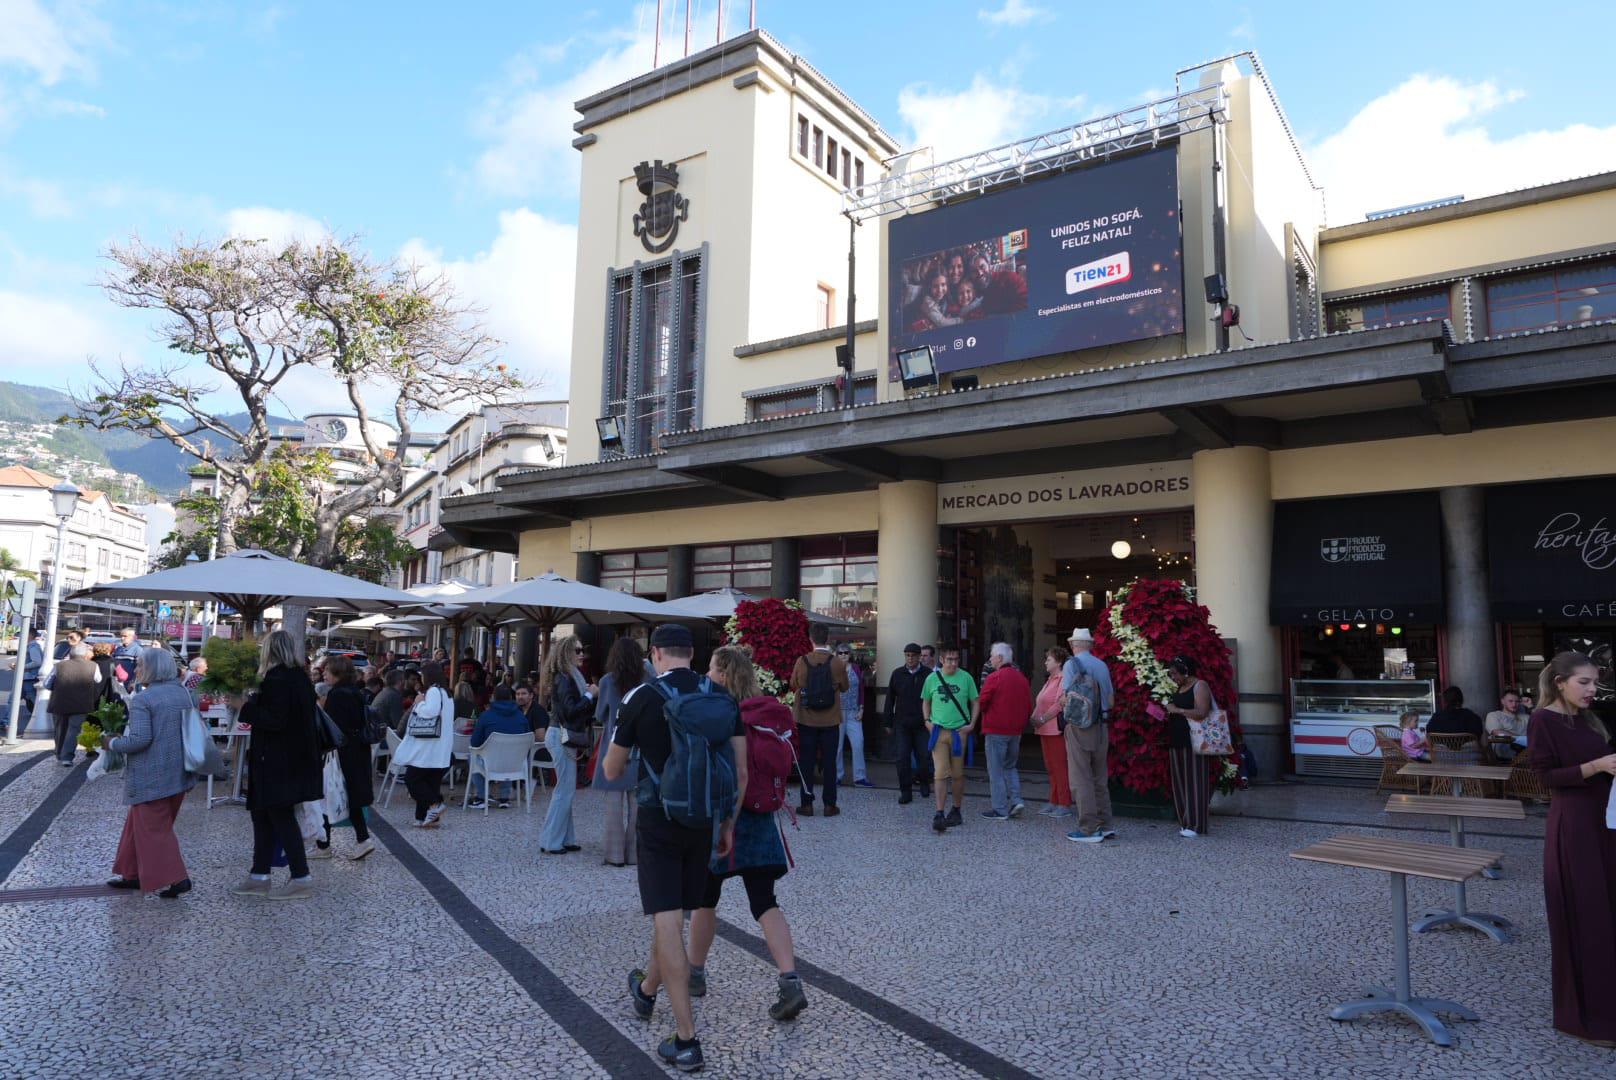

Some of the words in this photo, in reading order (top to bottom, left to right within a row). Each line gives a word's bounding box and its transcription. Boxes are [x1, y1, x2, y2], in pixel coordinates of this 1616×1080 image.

[1051, 221, 1090, 238] UNIDOS
[1093, 216, 1109, 229] NO
[1111, 207, 1143, 224] SOFÁ.
[1062, 235, 1090, 250] FELIZ
[1092, 225, 1132, 243] NATAL!
[1038, 302, 1082, 317] Especialistas
[1082, 299, 1095, 308] em
[1095, 287, 1163, 306] electrodomésticos
[942, 491, 1022, 510] MERCADO
[1028, 488, 1063, 504] DOS
[1068, 476, 1190, 501] LAVRADORES
[1348, 535, 1380, 545] PROUDLY
[1348, 543, 1386, 553] PRODUCED
[1349, 551, 1386, 561] PORTUGAL
[1318, 608, 1394, 621] GELATO
[1562, 601, 1616, 617] CAFÉ
